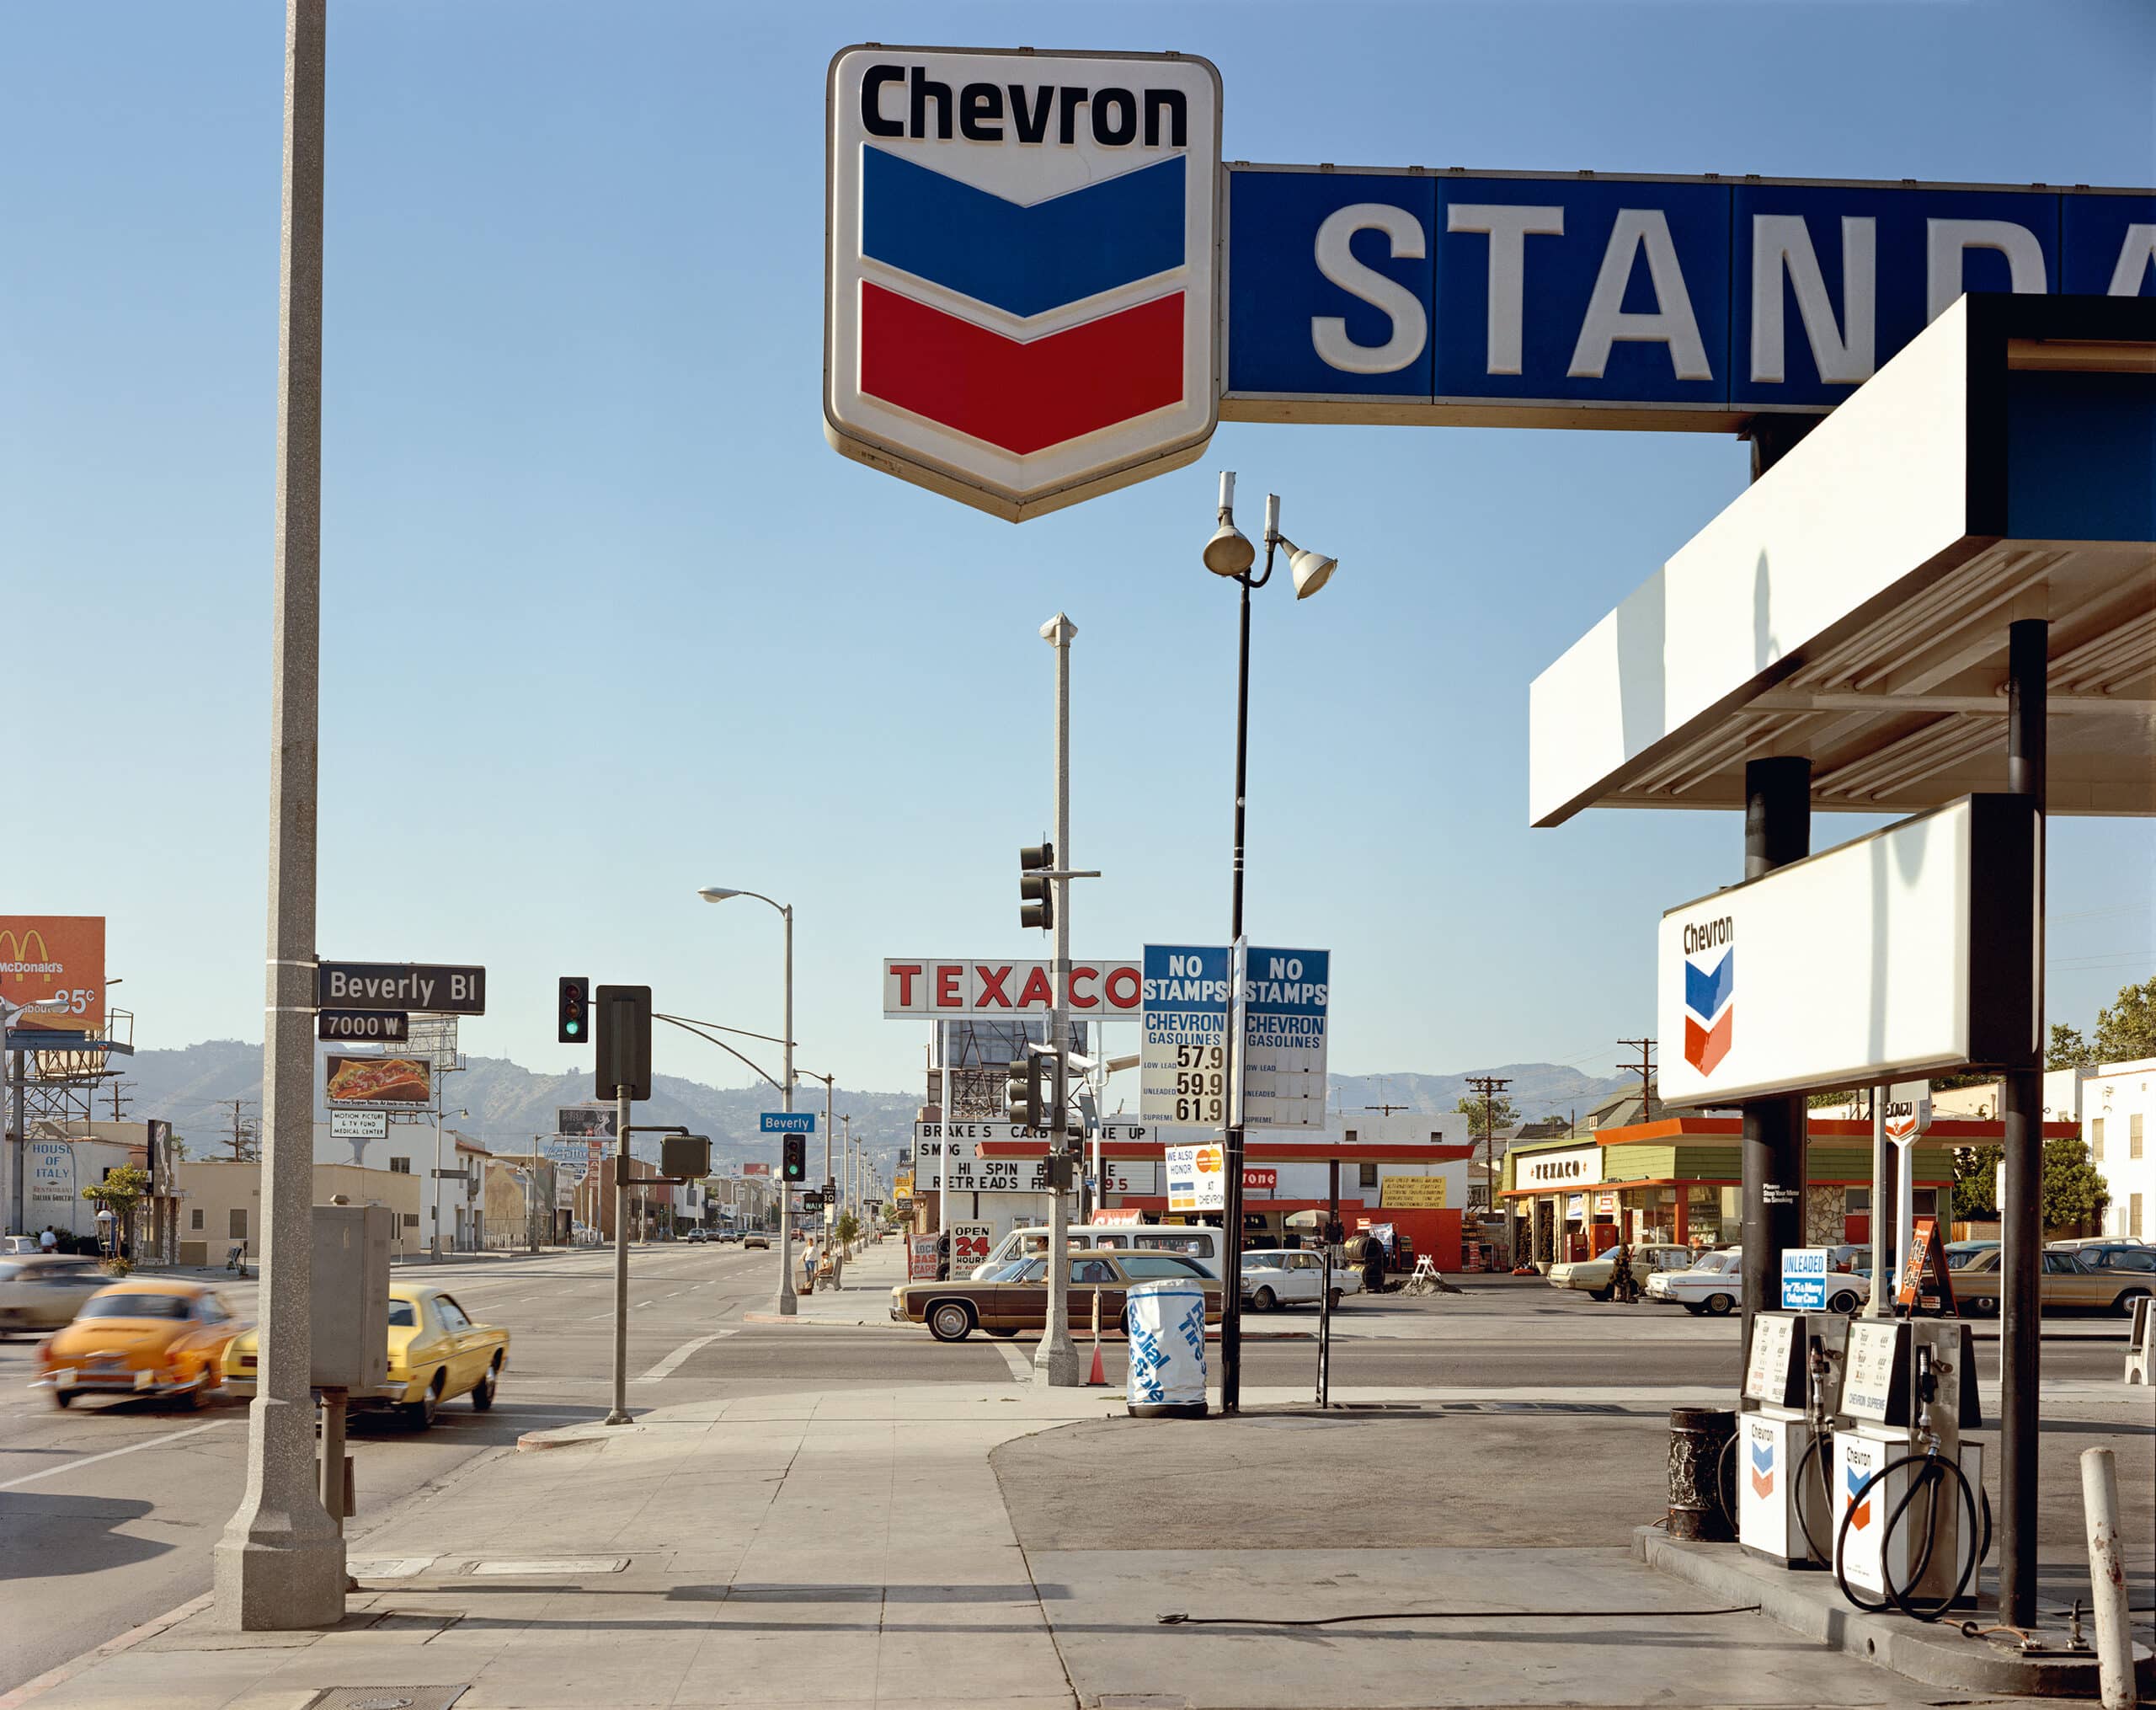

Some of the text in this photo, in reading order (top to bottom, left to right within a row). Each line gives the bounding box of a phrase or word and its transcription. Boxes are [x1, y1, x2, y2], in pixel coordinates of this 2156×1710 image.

[861, 64, 1187, 147] Chevron
[1310, 202, 2156, 385] STAN
[1684, 916, 1733, 955] Chevron
[0, 962, 63, 973] McDonald's
[1169, 954, 1203, 978] NO
[1269, 957, 1304, 981] NO
[330, 971, 476, 1007] Beverly Bl
[889, 965, 1142, 1009] TEXACO
[1143, 979, 1228, 1002] STAMPS
[1246, 981, 1328, 1006] STAMPS
[328, 1017, 399, 1036] 7000 W
[1145, 1013, 1225, 1032] CHEVRON
[1246, 1015, 1324, 1035] CHEVRON
[1149, 1032, 1220, 1045] GASOLINES
[1248, 1034, 1321, 1049] GASOLINES
[1177, 1045, 1224, 1070] 57.9
[1177, 1072, 1223, 1096] 59.9
[1176, 1098, 1223, 1122] 61.9
[1886, 1101, 1913, 1118] EXACO
[766, 1117, 809, 1130] Beverly
[1129, 1127, 1145, 1140] UP
[921, 1143, 960, 1157] SMG
[1167, 1151, 1177, 1162] WE
[1177, 1150, 1193, 1162] ALSO
[45, 1156, 61, 1166] OF
[958, 1162, 1018, 1176] HI SPIN
[1170, 1164, 1193, 1175] HONOR
[1535, 1160, 1581, 1181] TEXACO
[36, 1168, 69, 1178] ITALY
[932, 1176, 1018, 1189] RETREADS
[805, 1202, 824, 1210] WALK
[1198, 1194, 1225, 1205] CHEVRO
[955, 1226, 990, 1236] OPEN
[955, 1236, 990, 1257] 24
[914, 1265, 937, 1274] CAPS
[1784, 1255, 1824, 1273] UNLEADED
[1129, 1301, 1171, 1371] Radial
[1849, 1392, 1886, 1411] CHEVRON SUPREME
[1752, 1423, 1774, 1442] Chevron
[1847, 1446, 1871, 1467] Chevron
